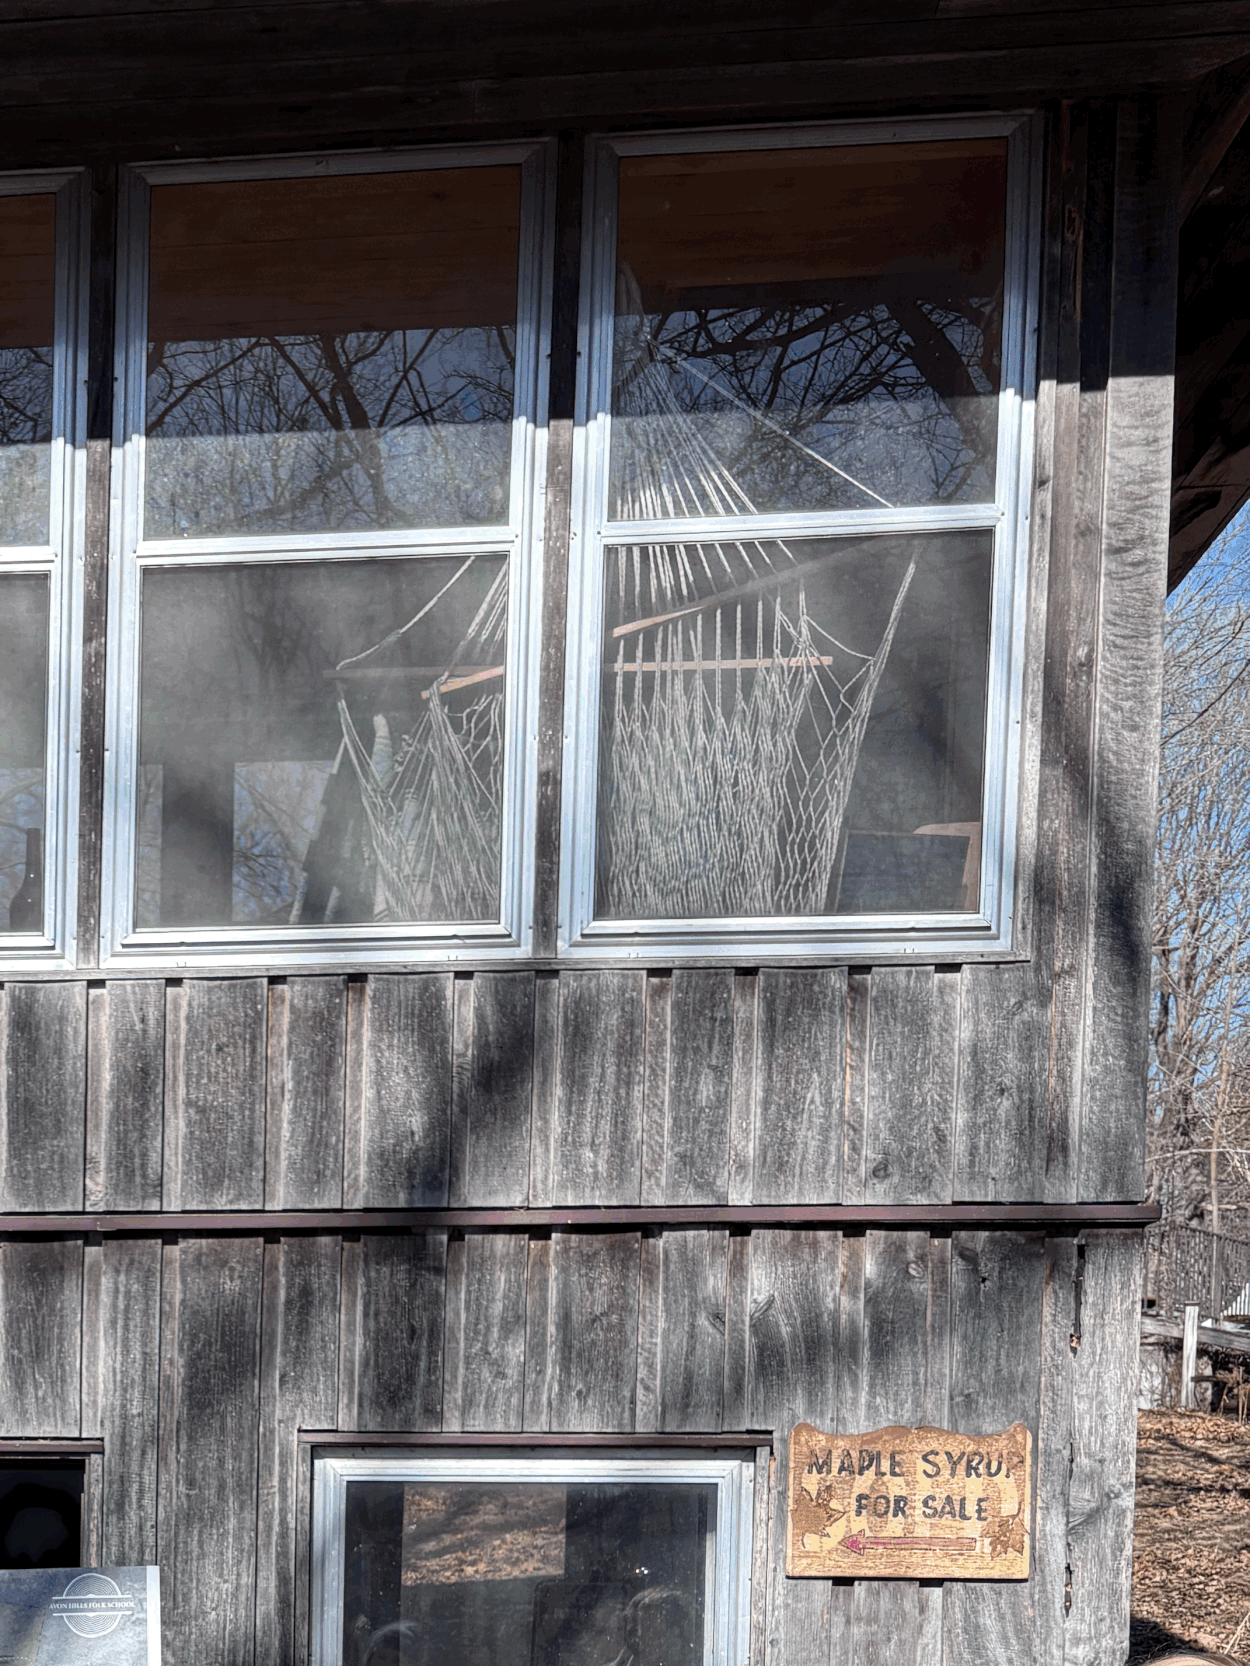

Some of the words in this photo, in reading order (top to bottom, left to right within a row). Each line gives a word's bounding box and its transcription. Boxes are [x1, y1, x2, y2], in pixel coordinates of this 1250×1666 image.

[807, 1447, 905, 1478] MAPLE
[854, 1492, 909, 1519] FOR
[921, 1493, 990, 1522] SALE
